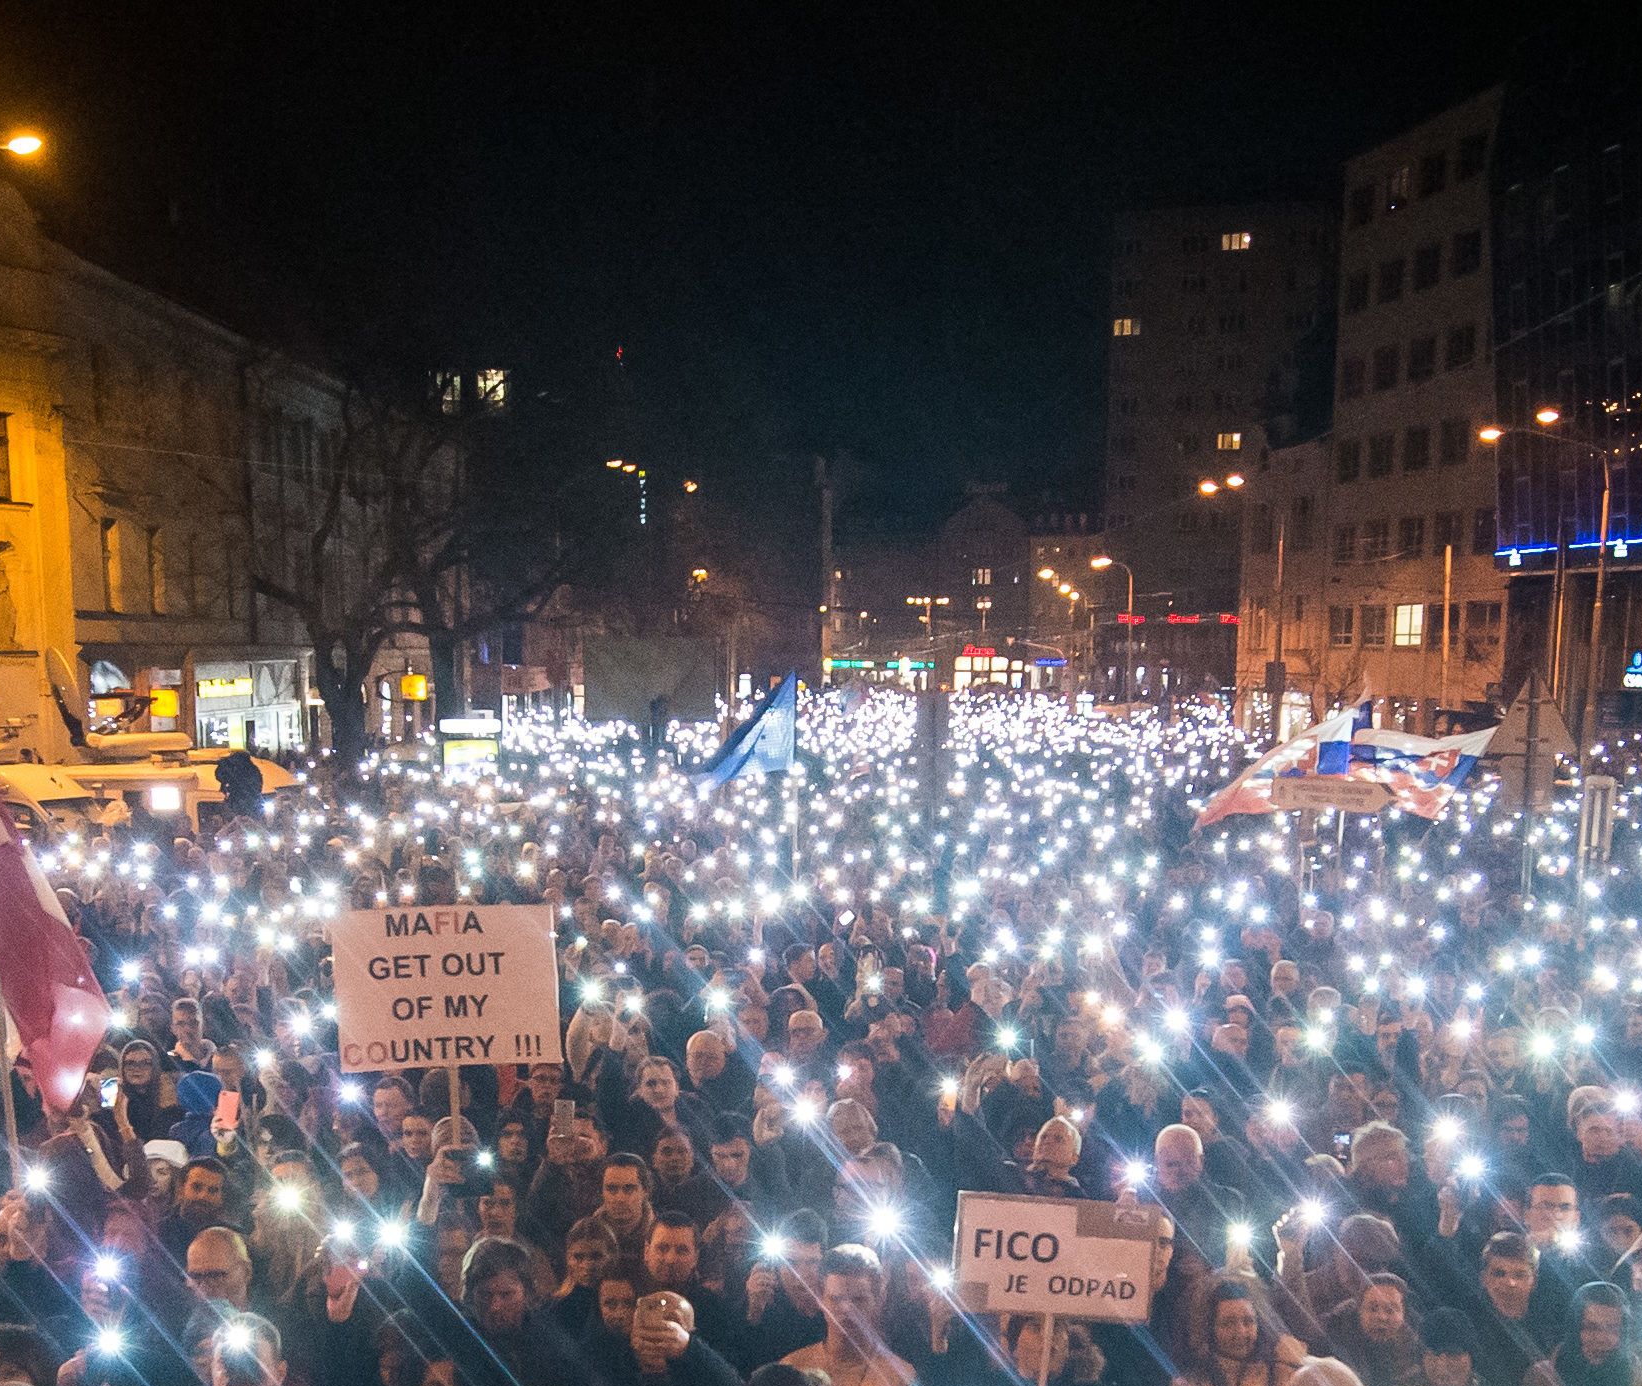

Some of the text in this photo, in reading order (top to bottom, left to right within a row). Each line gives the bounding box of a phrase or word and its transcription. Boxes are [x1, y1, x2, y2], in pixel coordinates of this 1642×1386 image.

[385, 911, 484, 937] MAFIA
[367, 951, 506, 981] GET OUT
[391, 994, 490, 1021] OF MY
[343, 1034, 542, 1067] COUNTRY !!!
[973, 1228, 1061, 1263] FICO
[1003, 1273, 1137, 1300] JE ODPAD
